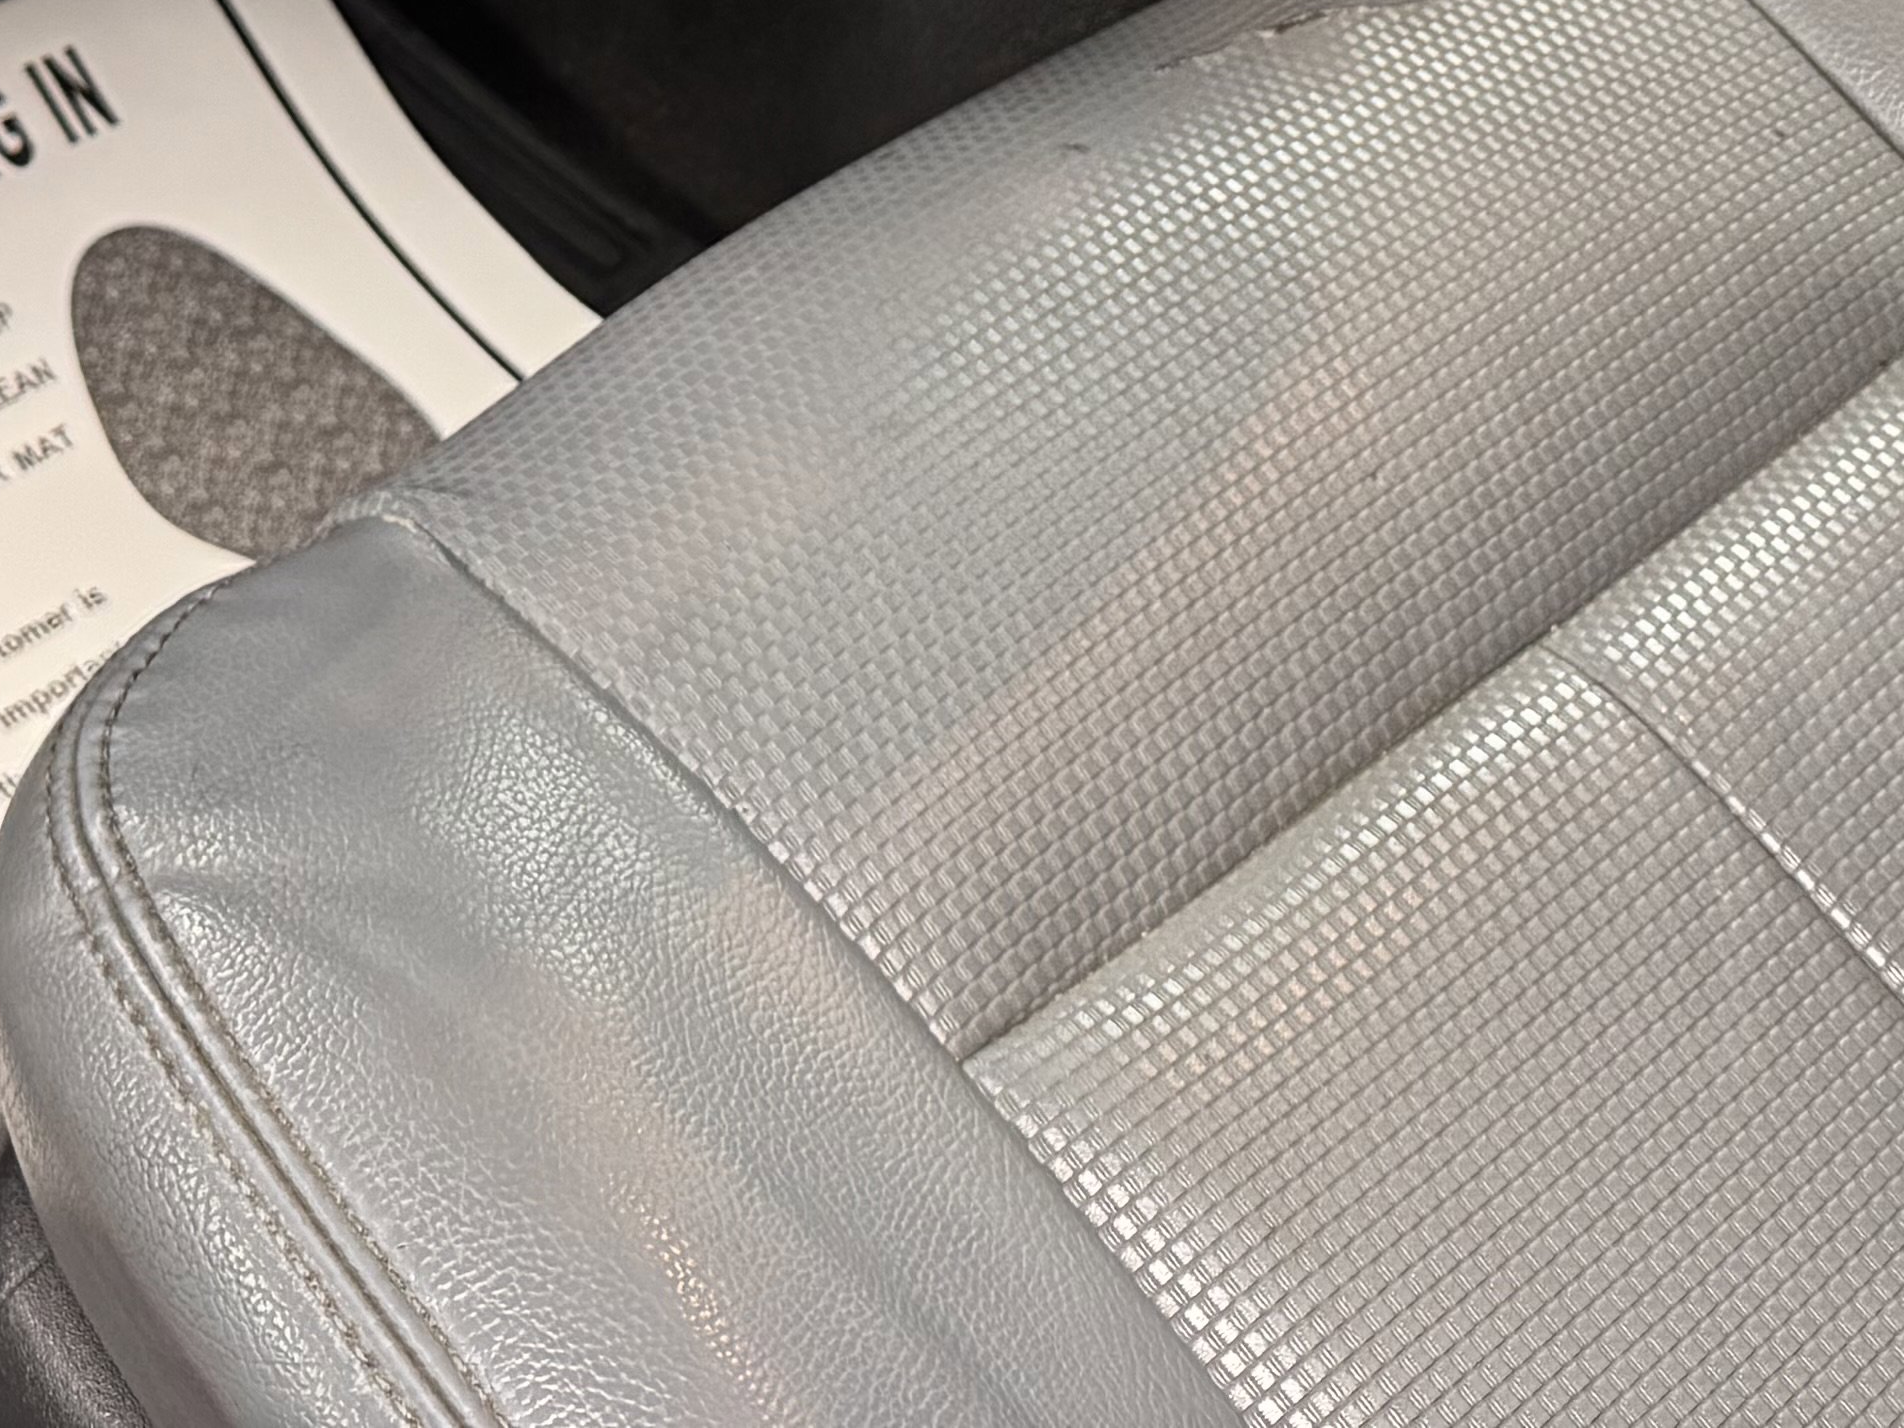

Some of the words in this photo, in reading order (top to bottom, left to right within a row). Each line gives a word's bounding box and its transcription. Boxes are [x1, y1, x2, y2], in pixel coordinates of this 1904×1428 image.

[23, 43, 121, 144] IN
[11, 423, 77, 471] MAT
[77, 584, 108, 611] is
